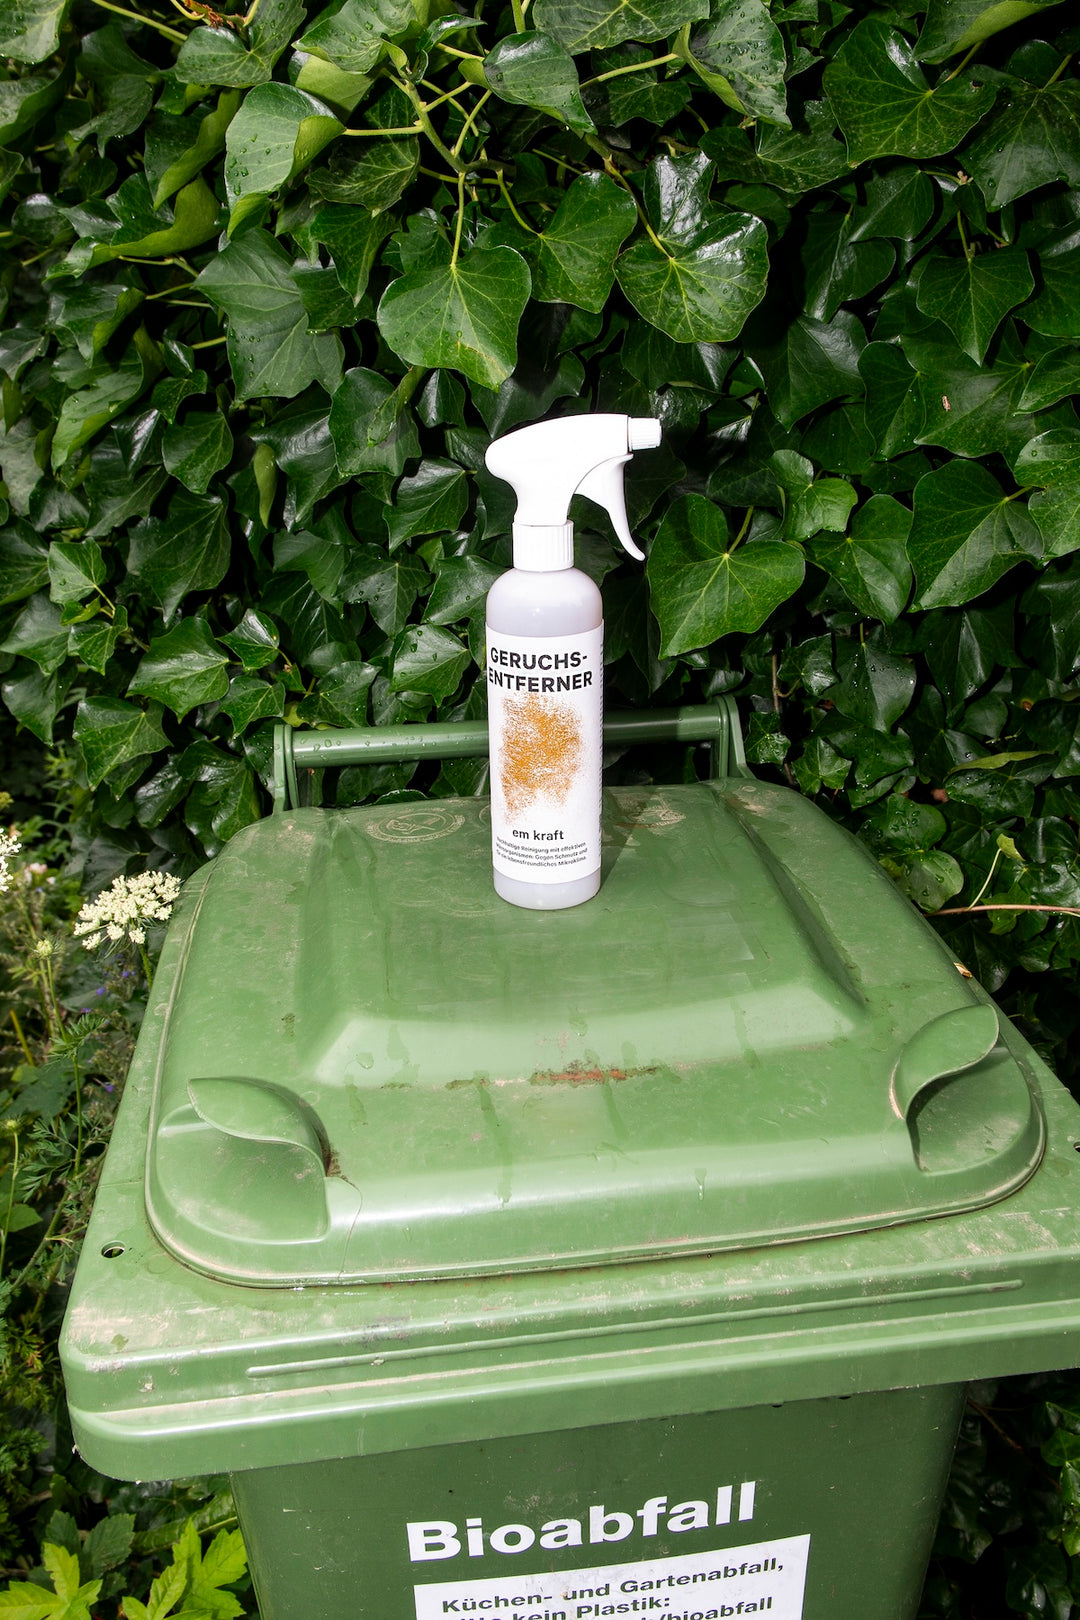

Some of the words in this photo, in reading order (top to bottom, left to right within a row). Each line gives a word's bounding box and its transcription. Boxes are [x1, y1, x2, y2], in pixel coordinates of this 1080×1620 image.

[490, 646, 588, 671] GERUCHS-
[488, 666, 593, 693] ENTFERNER
[512, 829, 529, 840] em
[533, 829, 564, 841] kraft
[406, 1481, 756, 1562] Bioabfall
[442, 1593, 553, 1613] Küchen-
[563, 1583, 610, 1601] und
[620, 1557, 783, 1593] Gartenabfall,
[576, 1596, 670, 1619] Plastik:
